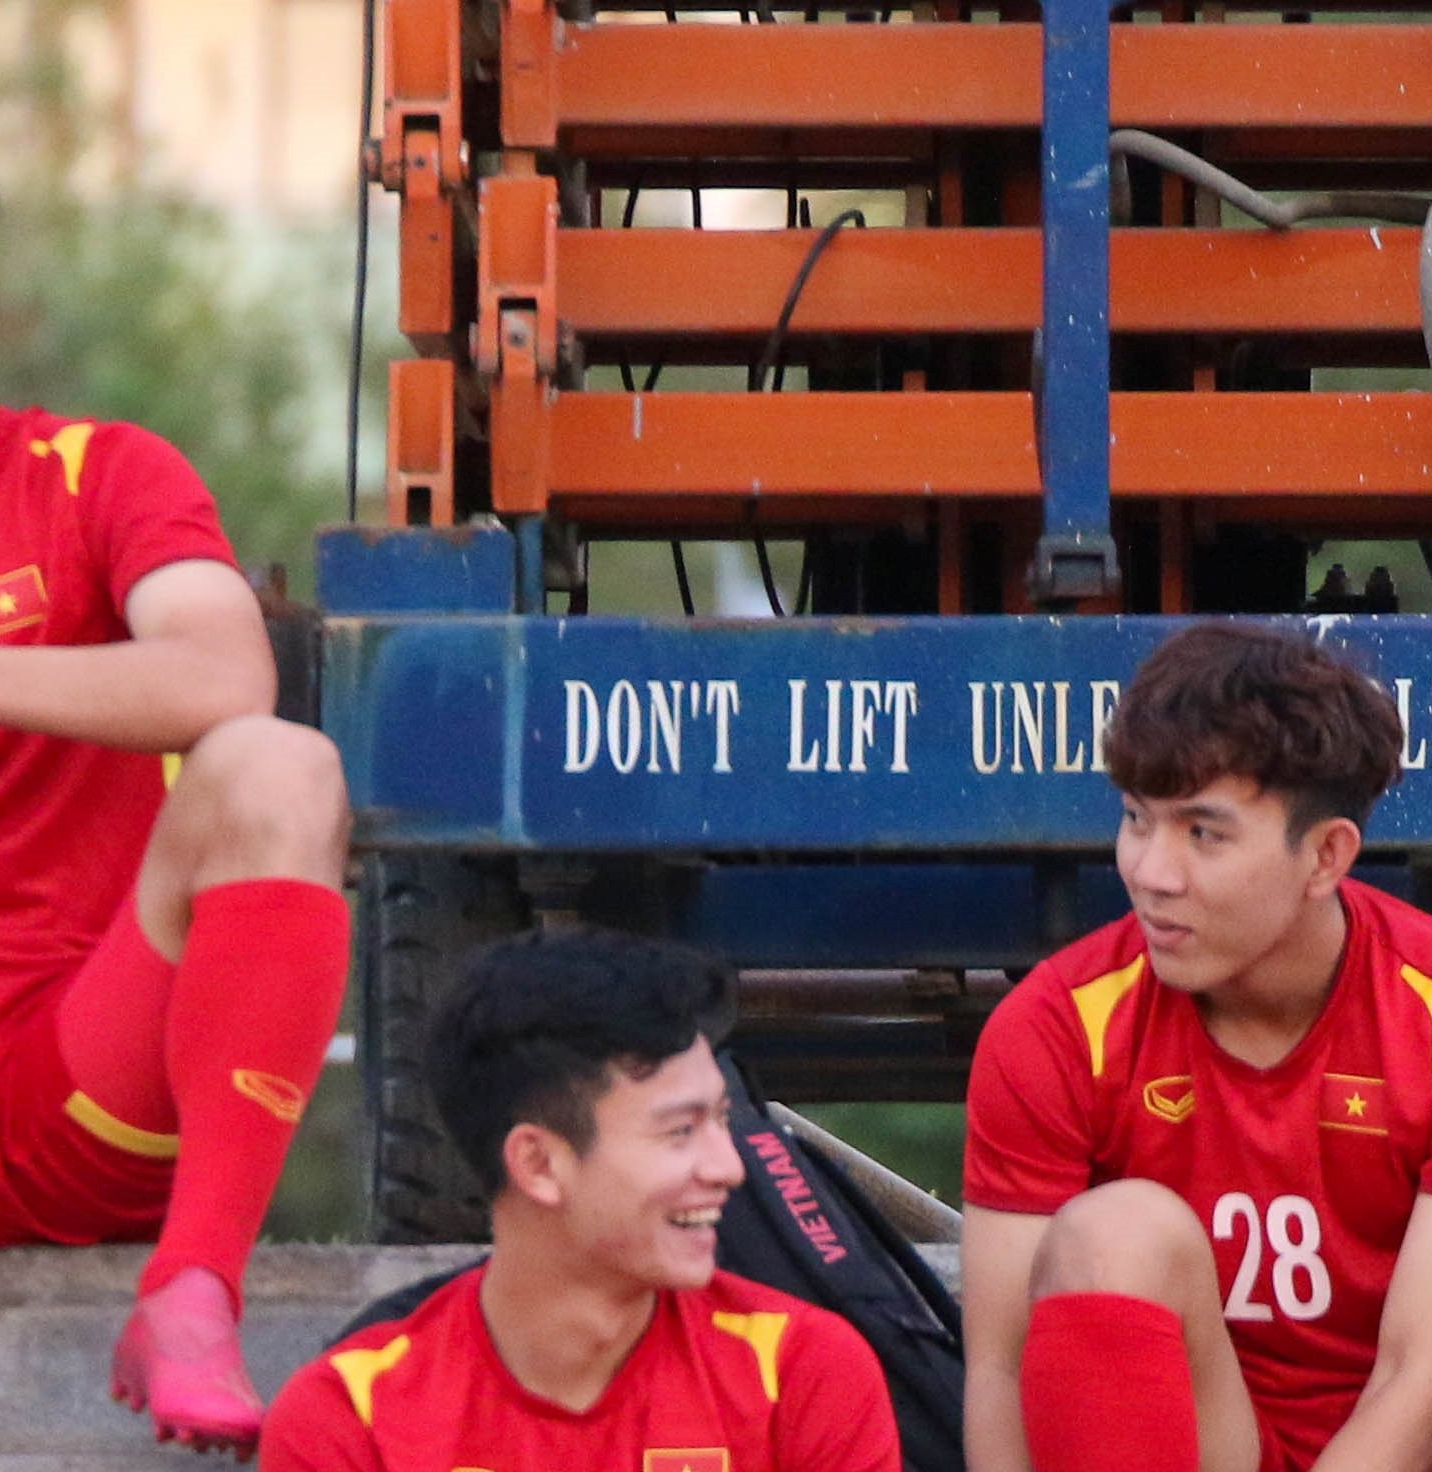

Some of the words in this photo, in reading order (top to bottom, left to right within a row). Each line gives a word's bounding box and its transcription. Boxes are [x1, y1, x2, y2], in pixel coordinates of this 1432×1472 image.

[563, 679, 739, 774] DON'T
[786, 678, 919, 773] LIFT
[967, 680, 1121, 774] UNLE
[746, 1131, 849, 1265] VIETNAM
[1212, 1191, 1333, 1322] 28
